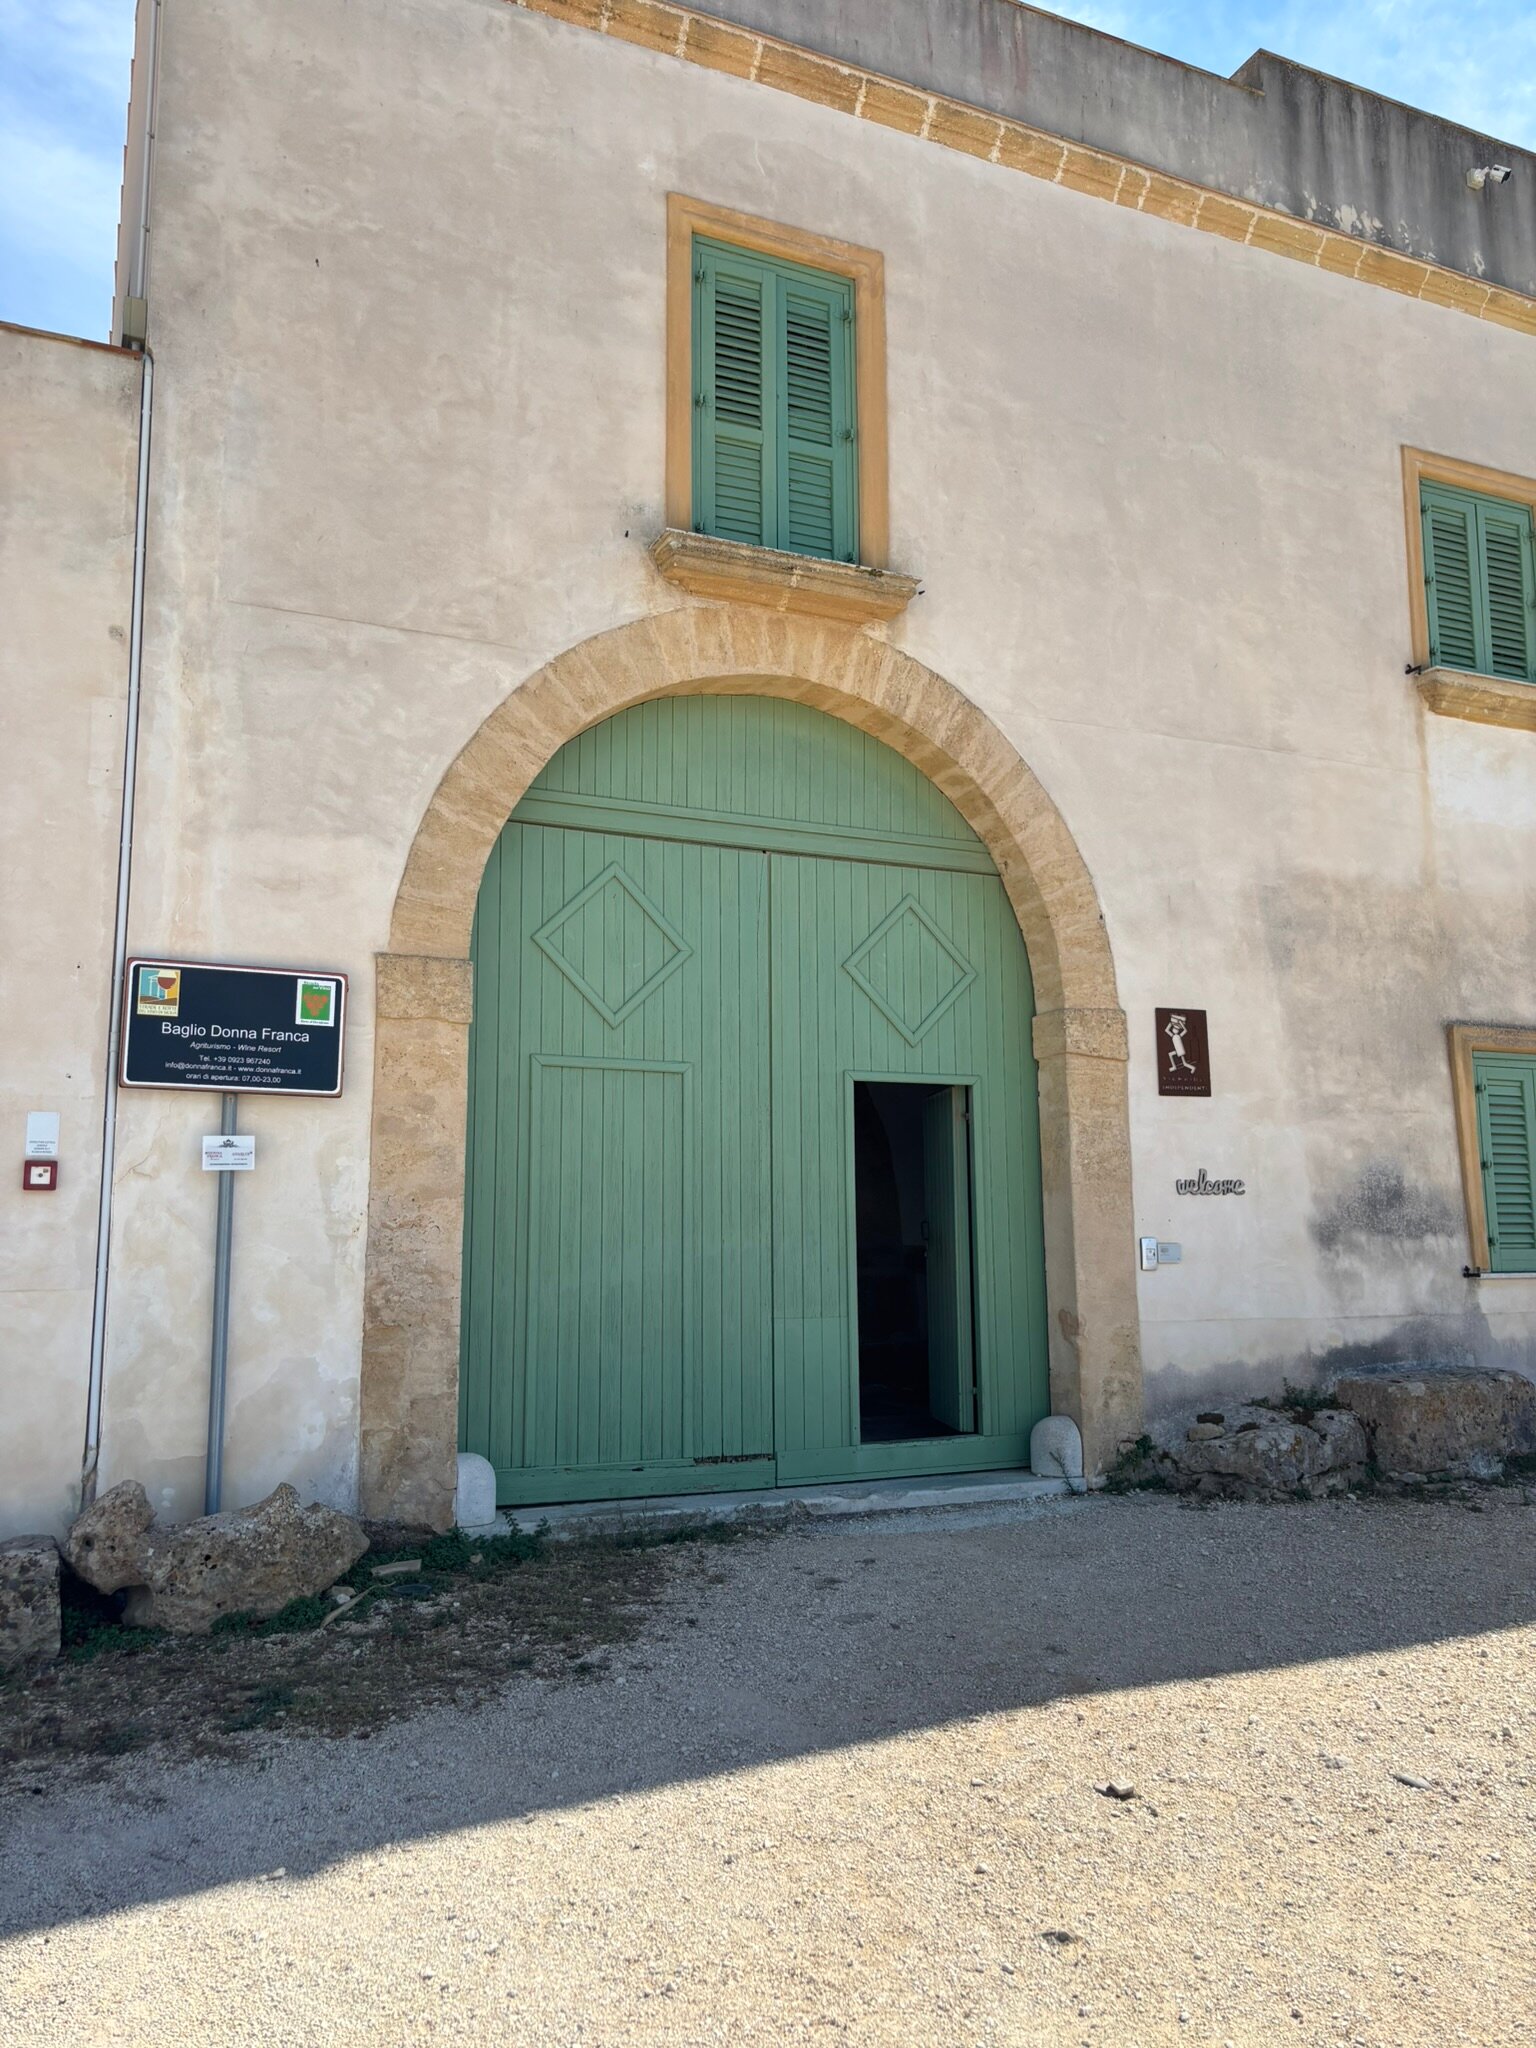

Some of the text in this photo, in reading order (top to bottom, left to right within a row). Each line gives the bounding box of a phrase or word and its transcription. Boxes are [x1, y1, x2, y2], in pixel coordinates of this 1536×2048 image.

[161, 1021, 310, 1042] Baglio Donna Franca
[190, 1041, 231, 1050] Agriturismo
[238, 1044, 256, 1052] Wine
[257, 1045, 282, 1053] Resort
[199, 1054, 211, 1062] Tel.
[214, 1055, 226, 1063] +39
[227, 1056, 245, 1064] 0923
[165, 1061, 232, 1071] info@donnafranca.it
[237, 1066, 302, 1075] www.donnafranca.it
[1175, 1167, 1246, 1196] welcome
